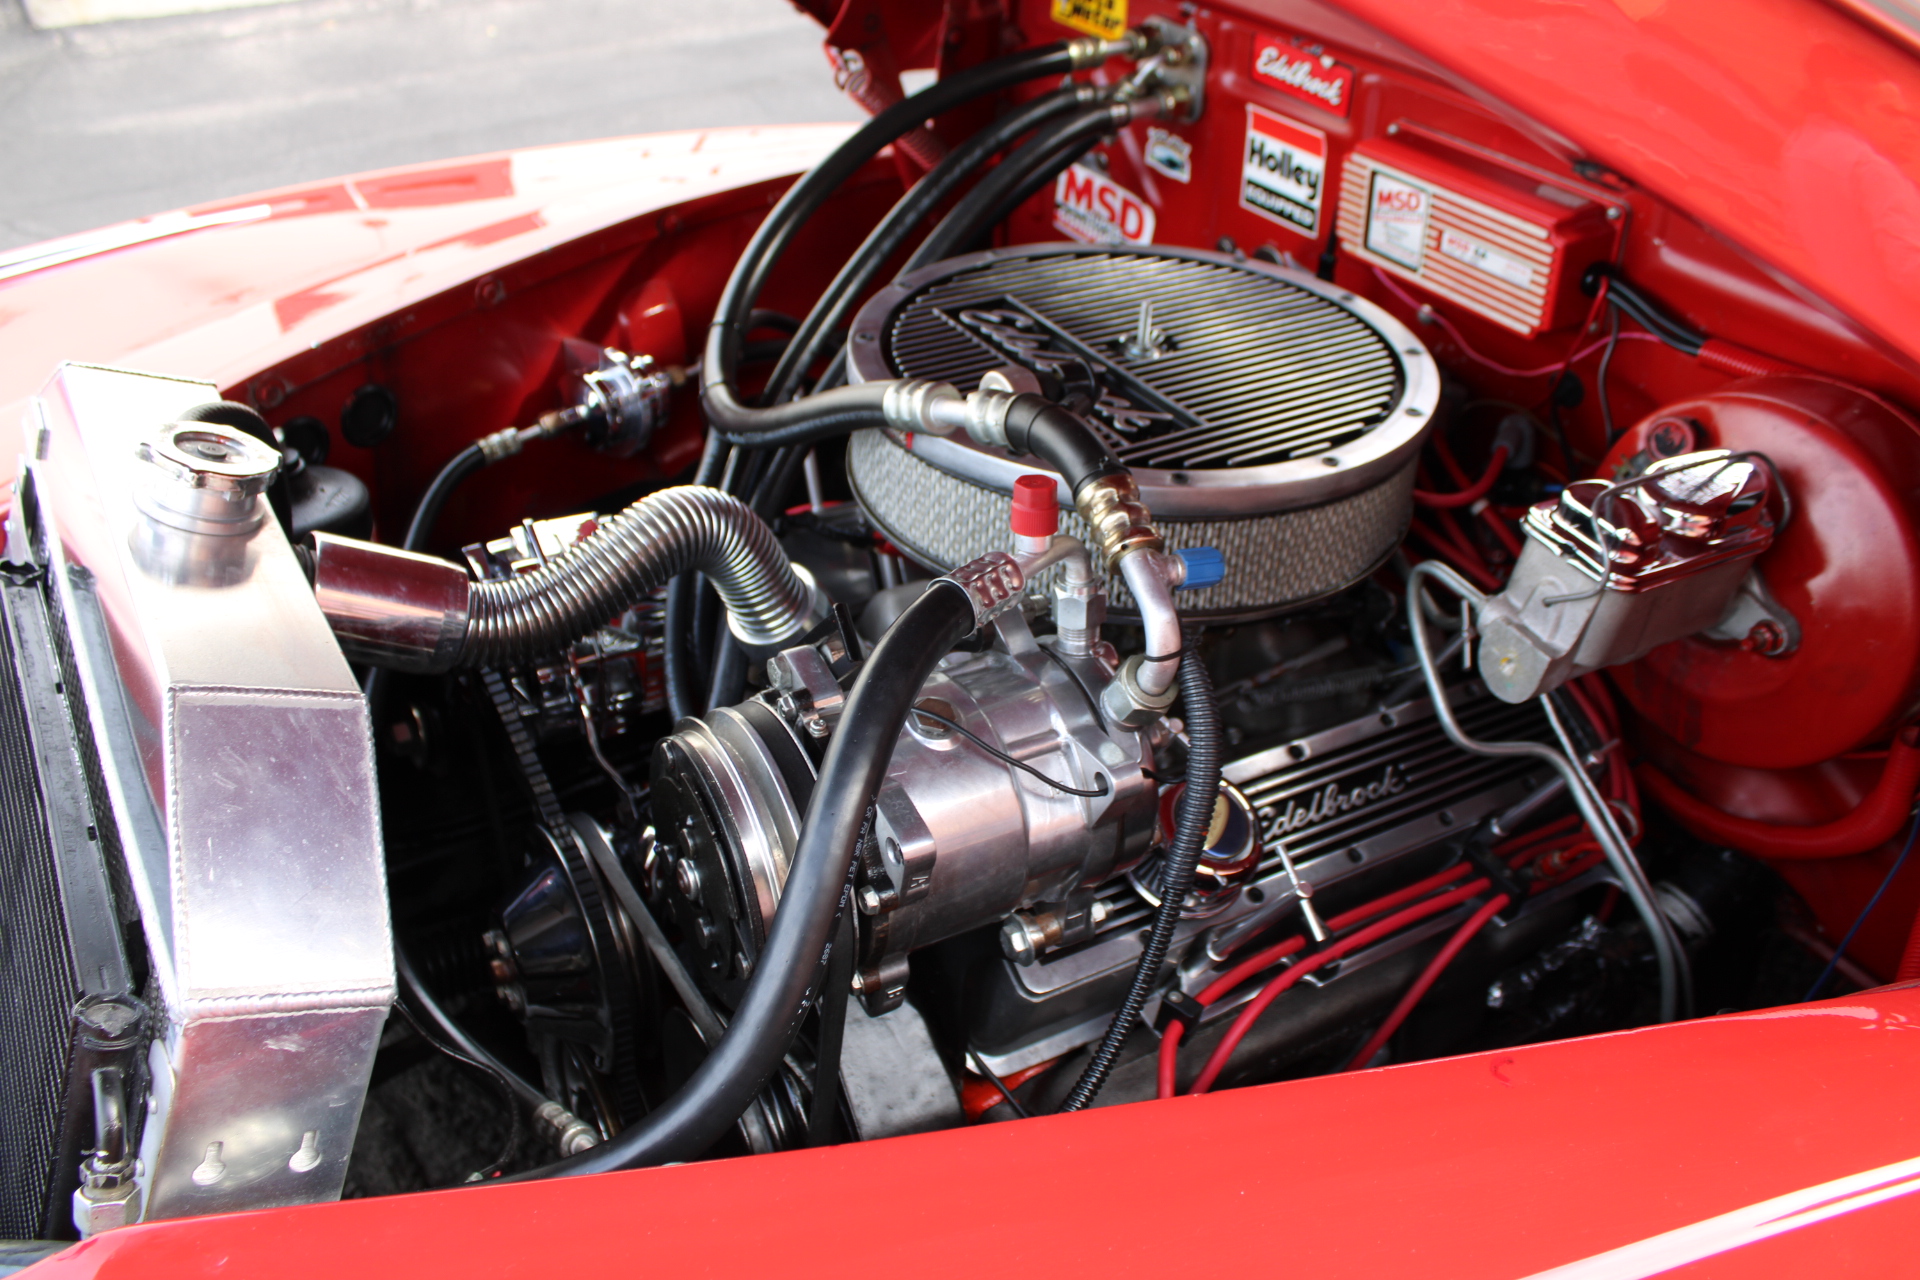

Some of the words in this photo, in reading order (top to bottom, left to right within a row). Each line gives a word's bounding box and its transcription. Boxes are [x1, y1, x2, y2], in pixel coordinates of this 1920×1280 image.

[1256, 46, 1342, 106] Edelbrock
[1250, 137, 1319, 200] Holley
[1064, 167, 1144, 240] MSD
[1246, 183, 1315, 227] EQUIPPED
[1377, 190, 1421, 212] MSD
[1259, 764, 1405, 842] Edelbrock
